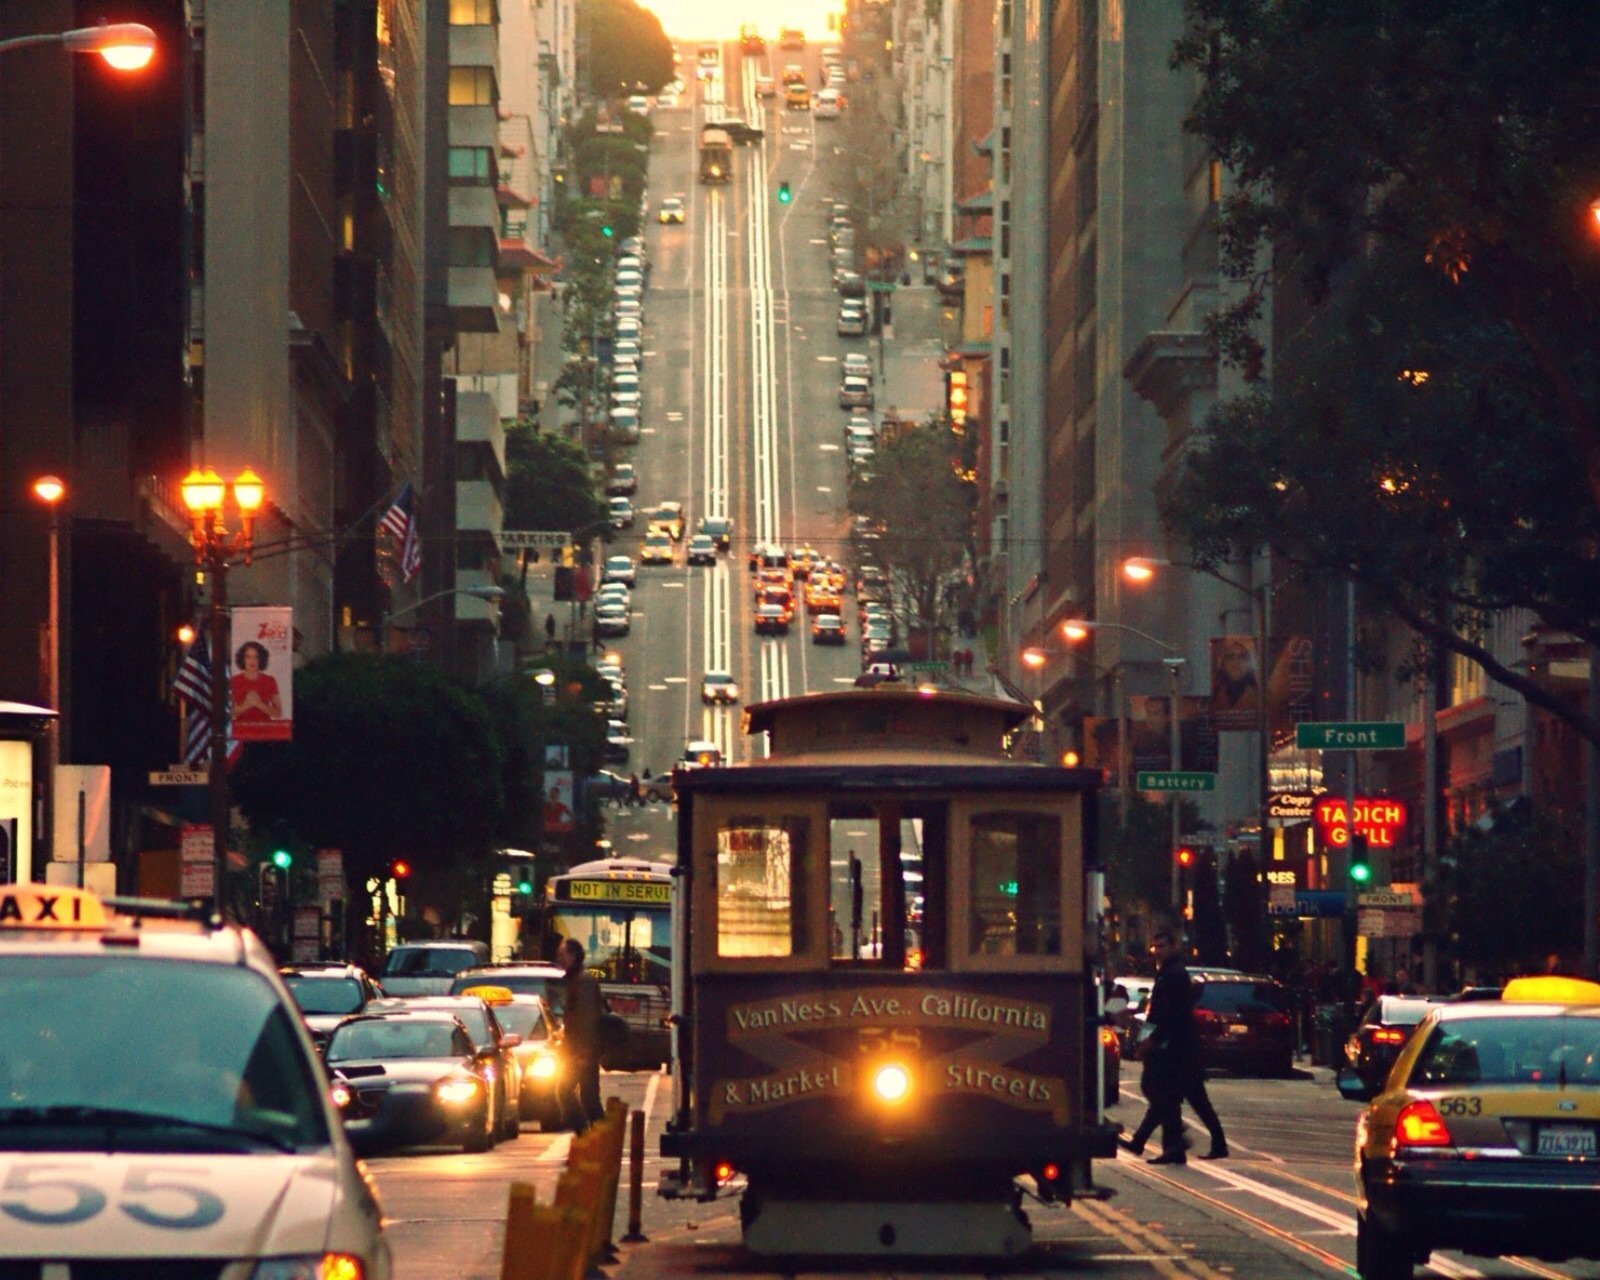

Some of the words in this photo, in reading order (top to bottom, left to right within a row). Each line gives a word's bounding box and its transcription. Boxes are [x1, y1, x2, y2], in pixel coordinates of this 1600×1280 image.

[1324, 730, 1378, 744] Front
[158, 773, 200, 783] FRONT
[1147, 776, 1206, 790] Battery
[1281, 794, 1313, 808] Copy
[1270, 808, 1313, 817] Center
[1331, 827, 1390, 844] GLL
[572, 883, 600, 897] NOT
[606, 885, 620, 898] IN
[1365, 895, 1405, 905] FRONT
[733, 1007, 778, 1031] Van
[782, 1001, 841, 1022] Ness
[920, 994, 1047, 1030] California
[725, 1084, 743, 1104] &
[748, 1067, 839, 1104] Market
[945, 1065, 1051, 1101] Streets
[1440, 1097, 1482, 1116] 563
[0, 1163, 226, 1229] 55
